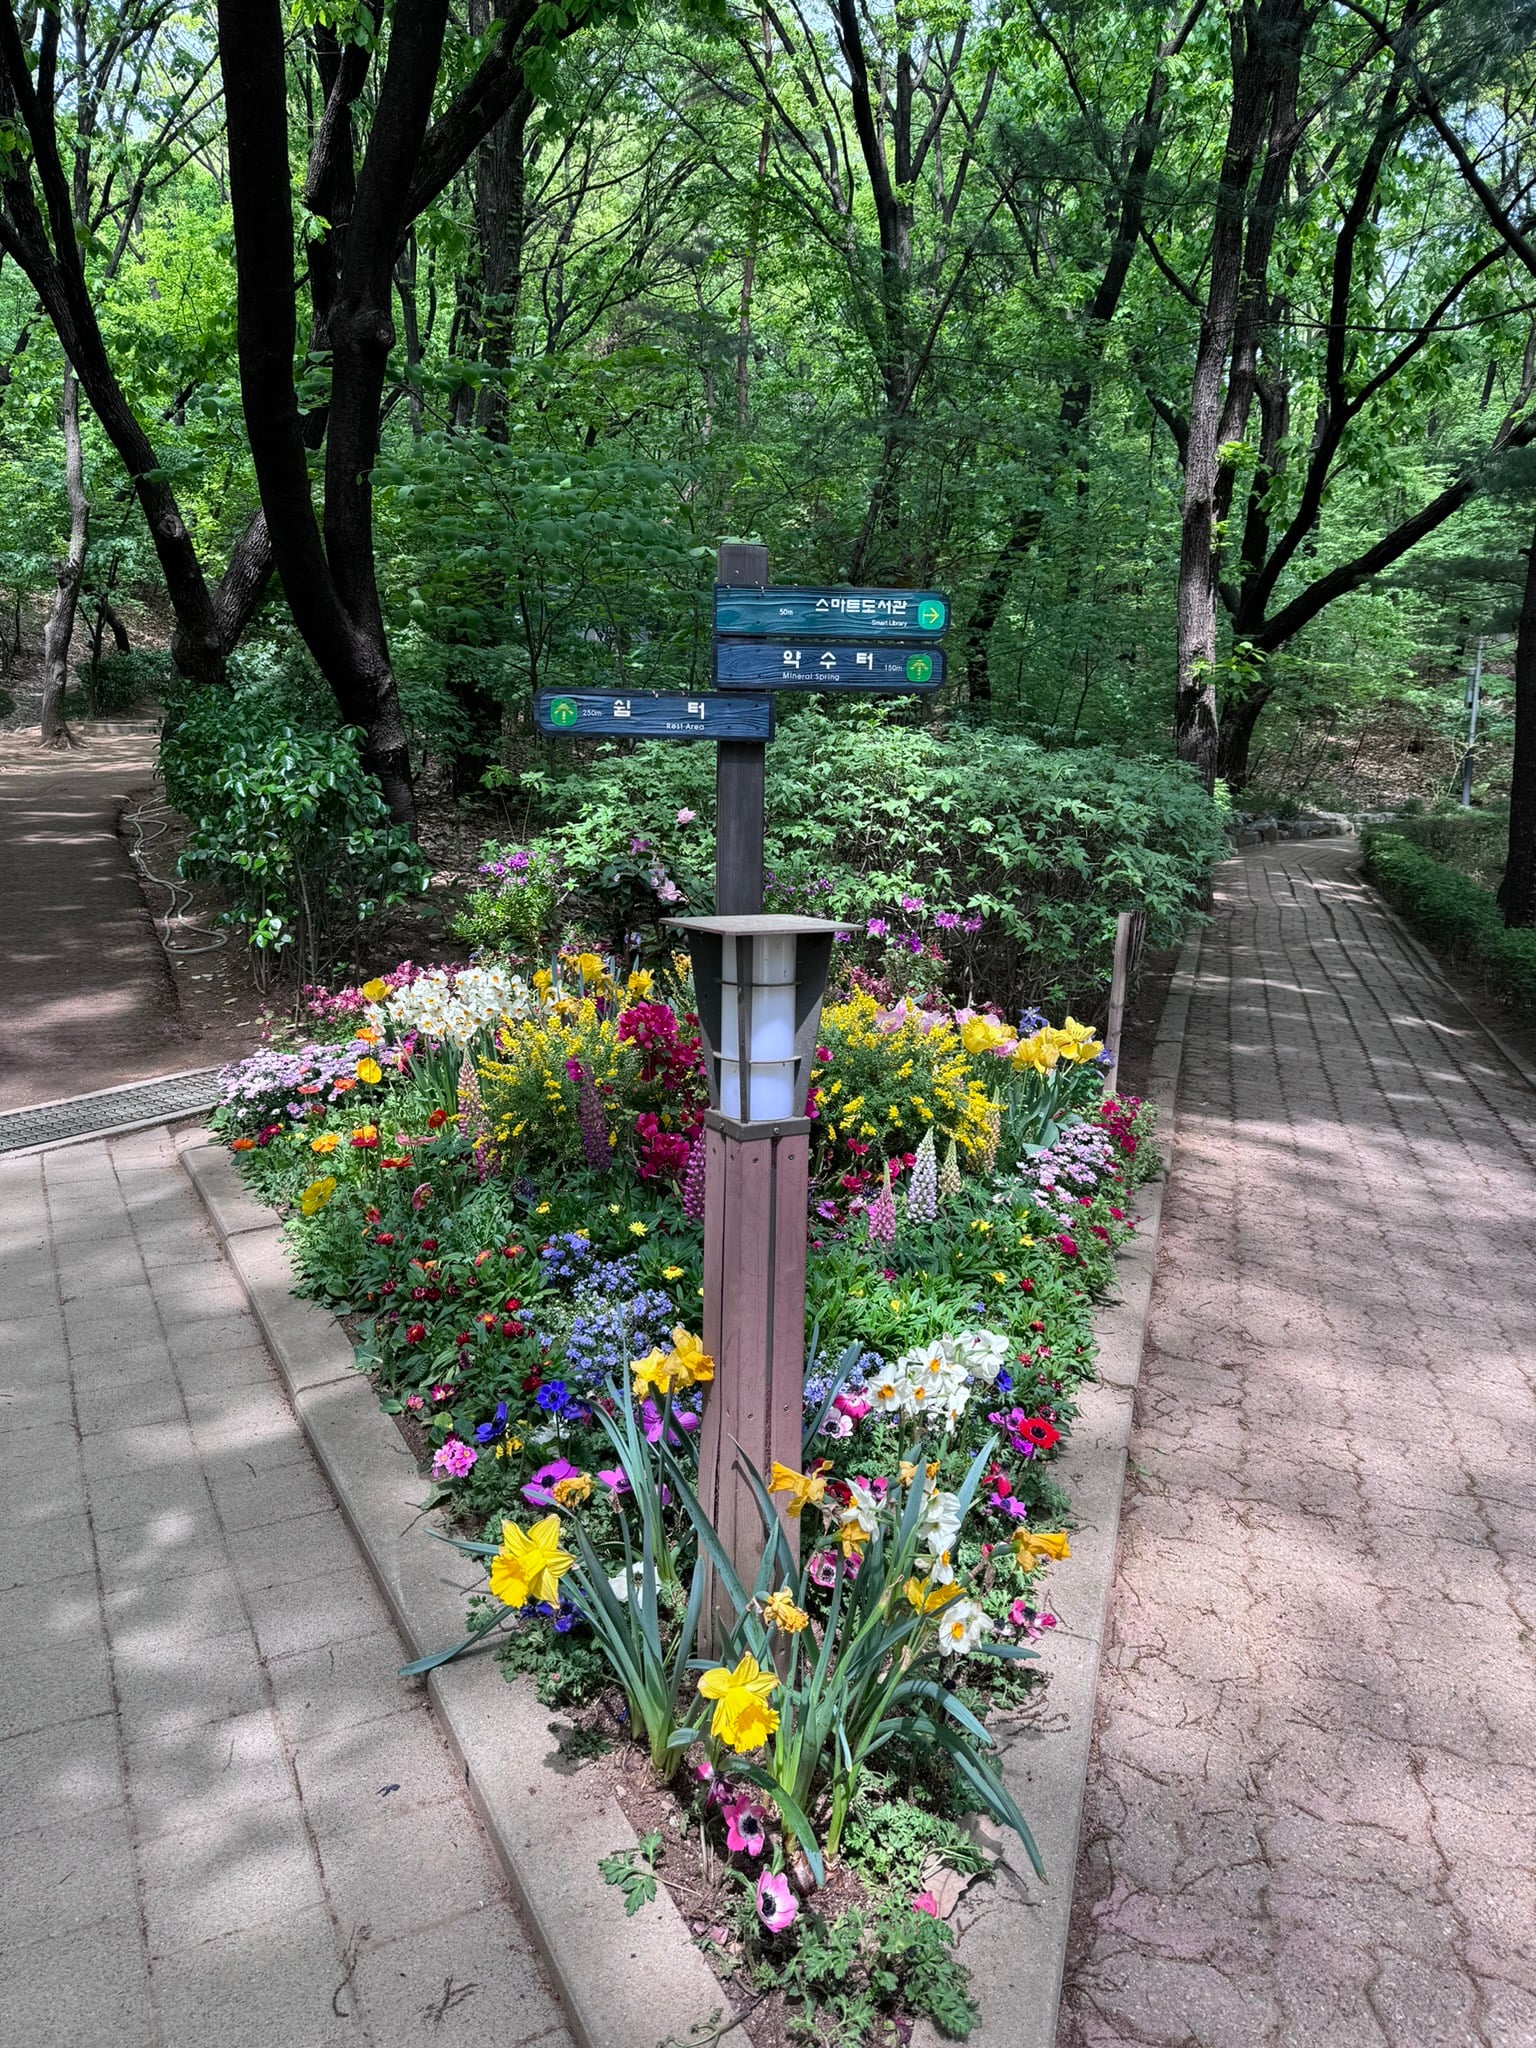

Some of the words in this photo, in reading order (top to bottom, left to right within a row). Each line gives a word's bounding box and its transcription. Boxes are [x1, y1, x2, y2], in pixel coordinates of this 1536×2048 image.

[815, 598, 908, 615] 스마트도서관
[779, 608, 794, 616] 50m
[888, 619, 908, 627] Library
[782, 672, 813, 680] Mineral
[815, 673, 840, 682] Spring
[582, 709, 603, 717] 250m
[666, 722, 685, 730] Rest
[685, 723, 705, 731] Area
